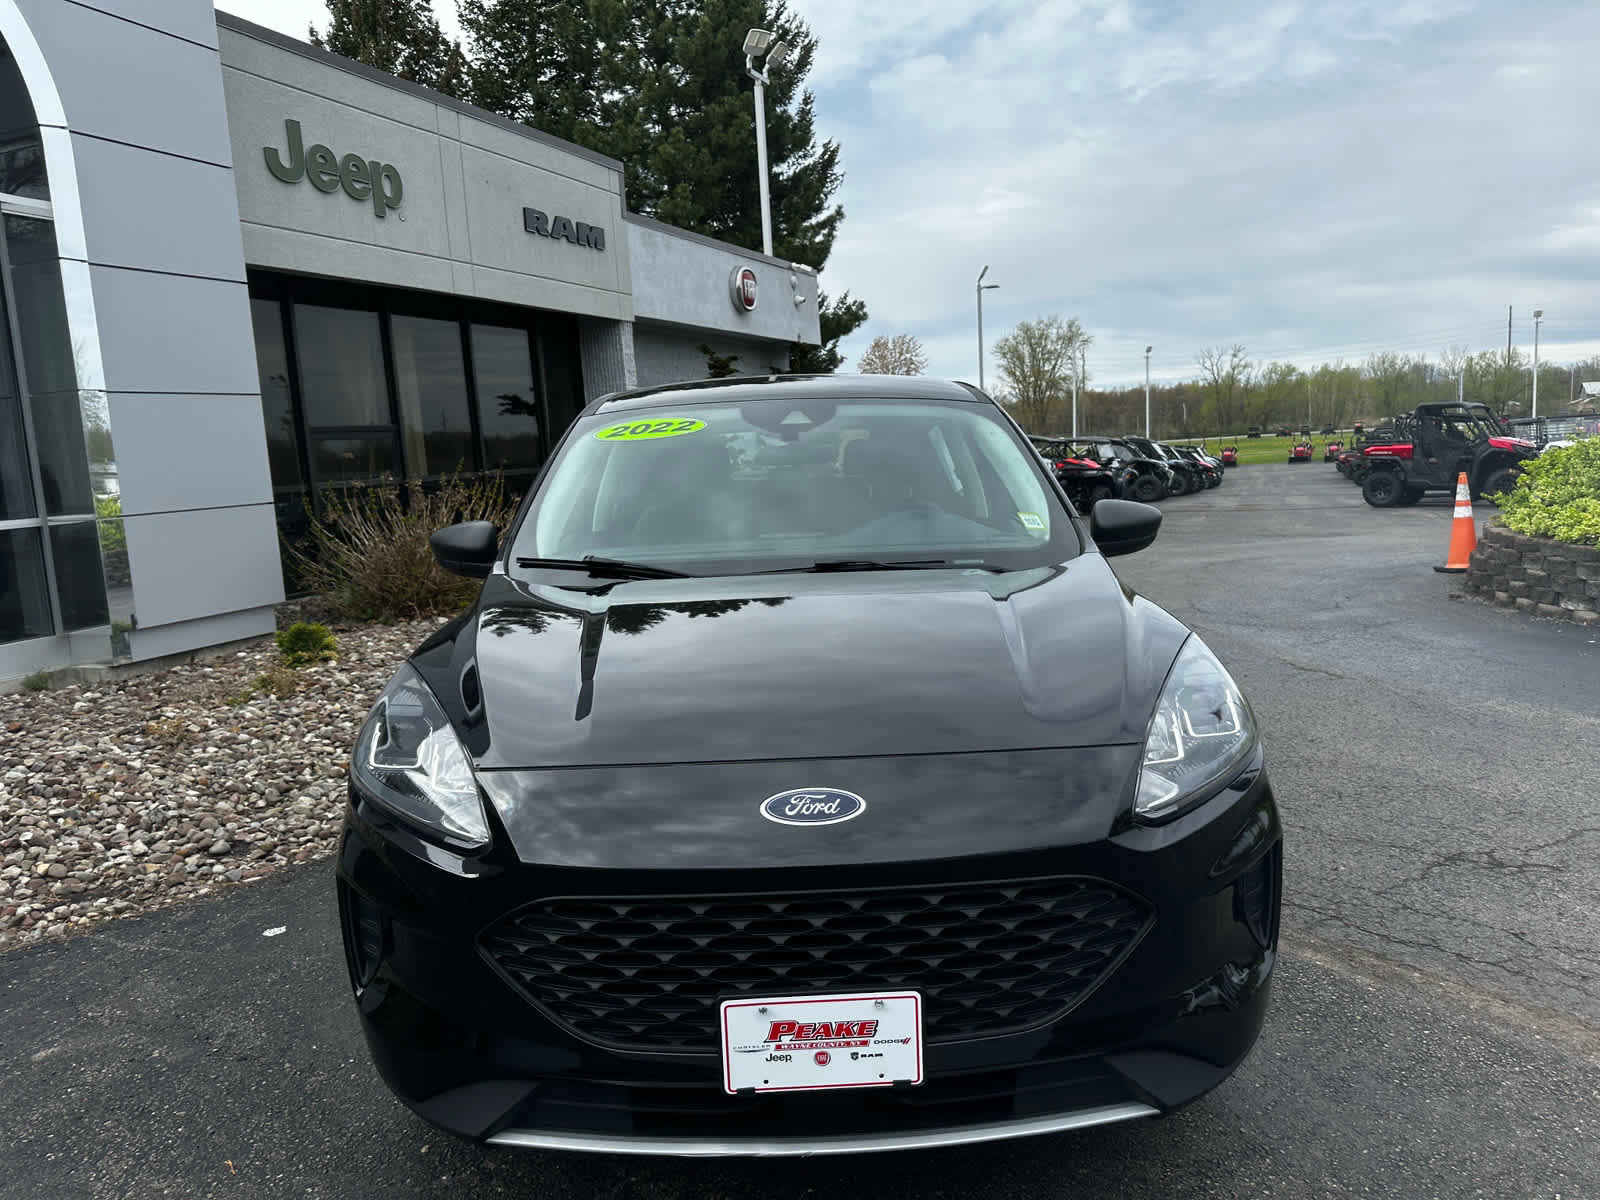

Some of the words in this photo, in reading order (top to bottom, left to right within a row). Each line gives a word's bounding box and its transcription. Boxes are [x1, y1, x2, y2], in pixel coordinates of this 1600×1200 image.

[263, 119, 403, 218] Jeep
[522, 206, 605, 252] RAM
[605, 420, 697, 439] 2022
[785, 794, 841, 816] Ford
[764, 1019, 879, 1043] PEAKE
[765, 1053, 791, 1063] Jeep
